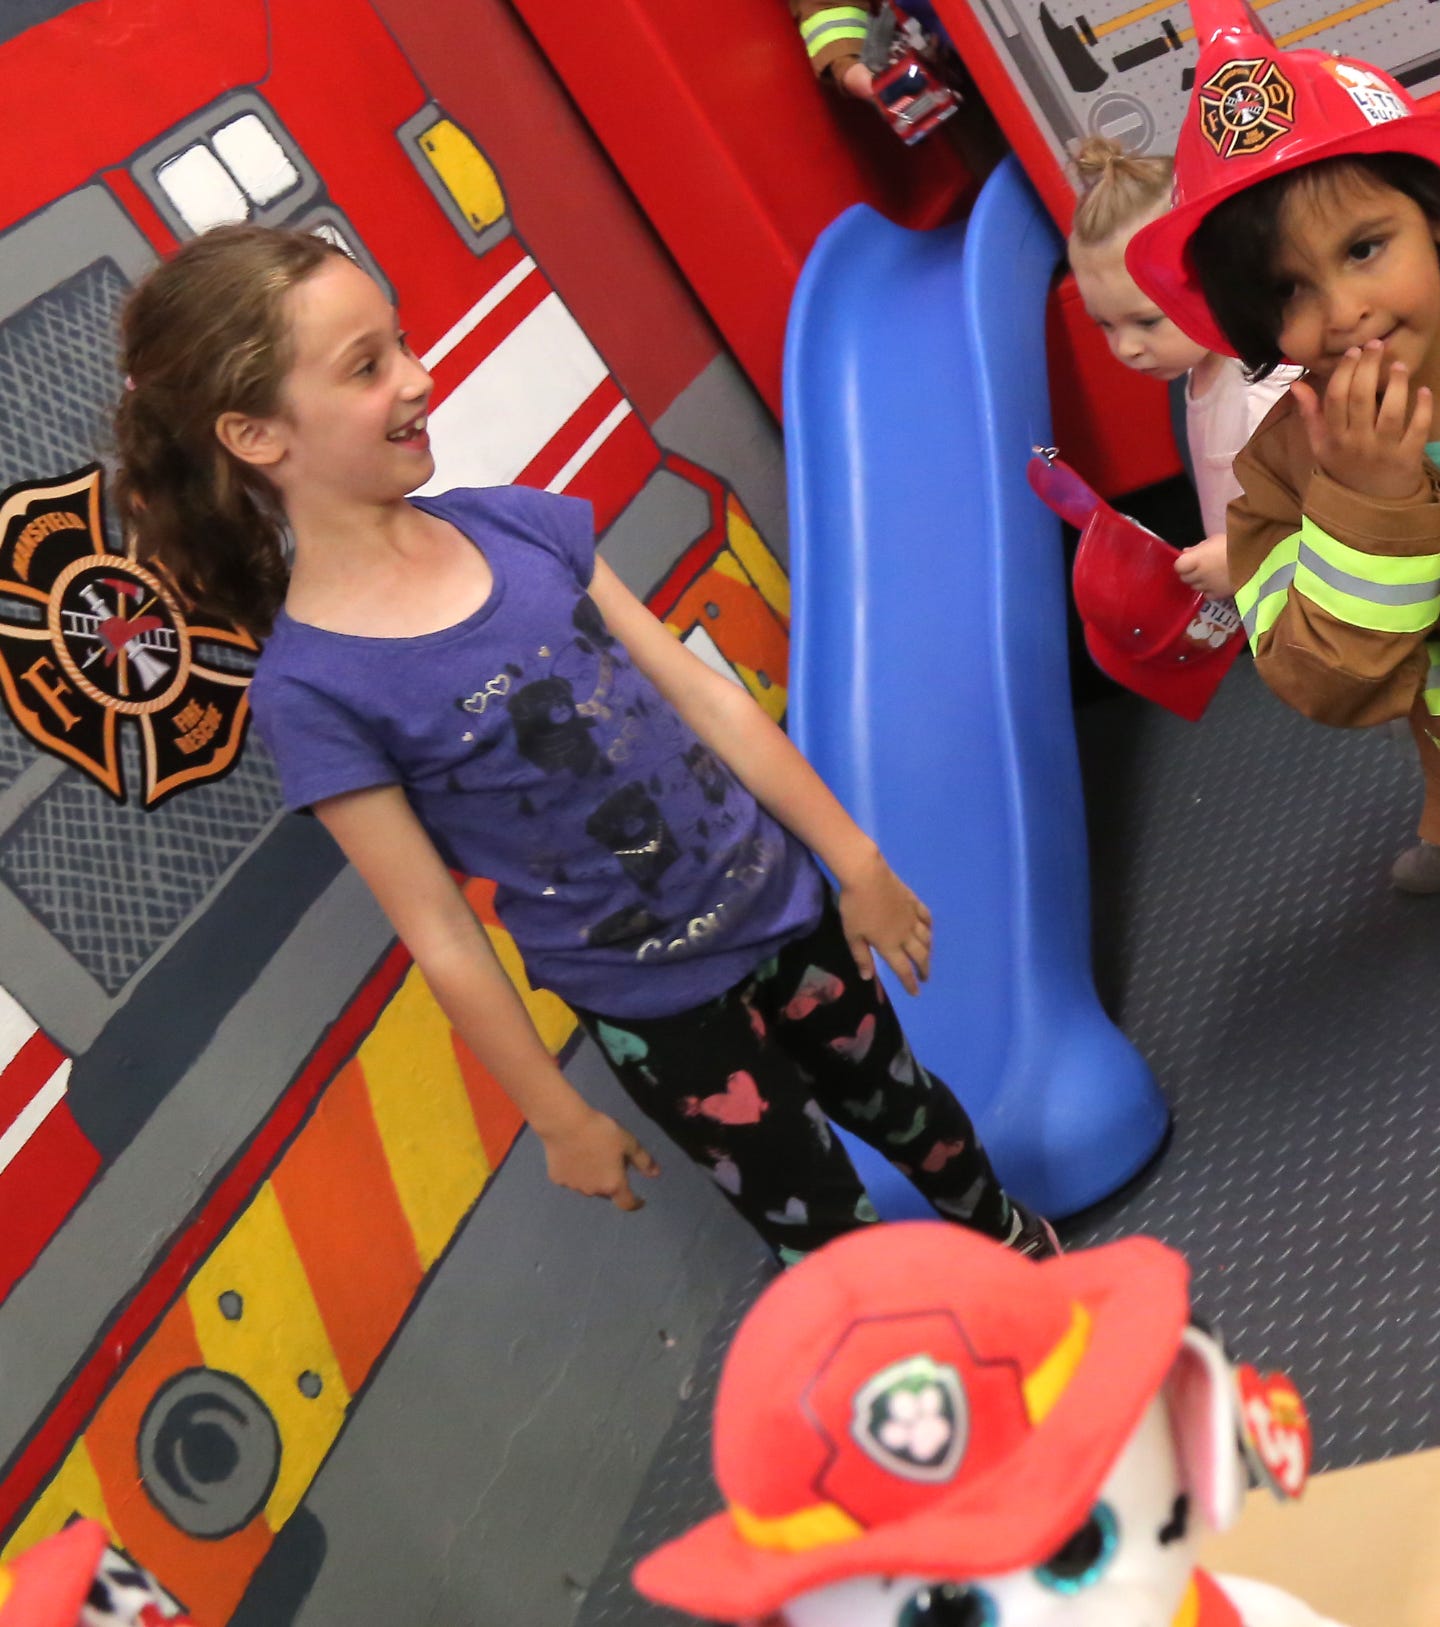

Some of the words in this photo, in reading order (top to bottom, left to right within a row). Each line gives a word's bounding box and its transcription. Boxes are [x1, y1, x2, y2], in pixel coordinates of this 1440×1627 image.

[1266, 84, 1285, 105] D
[1207, 109, 1219, 132] F
[20, 656, 82, 732] F
